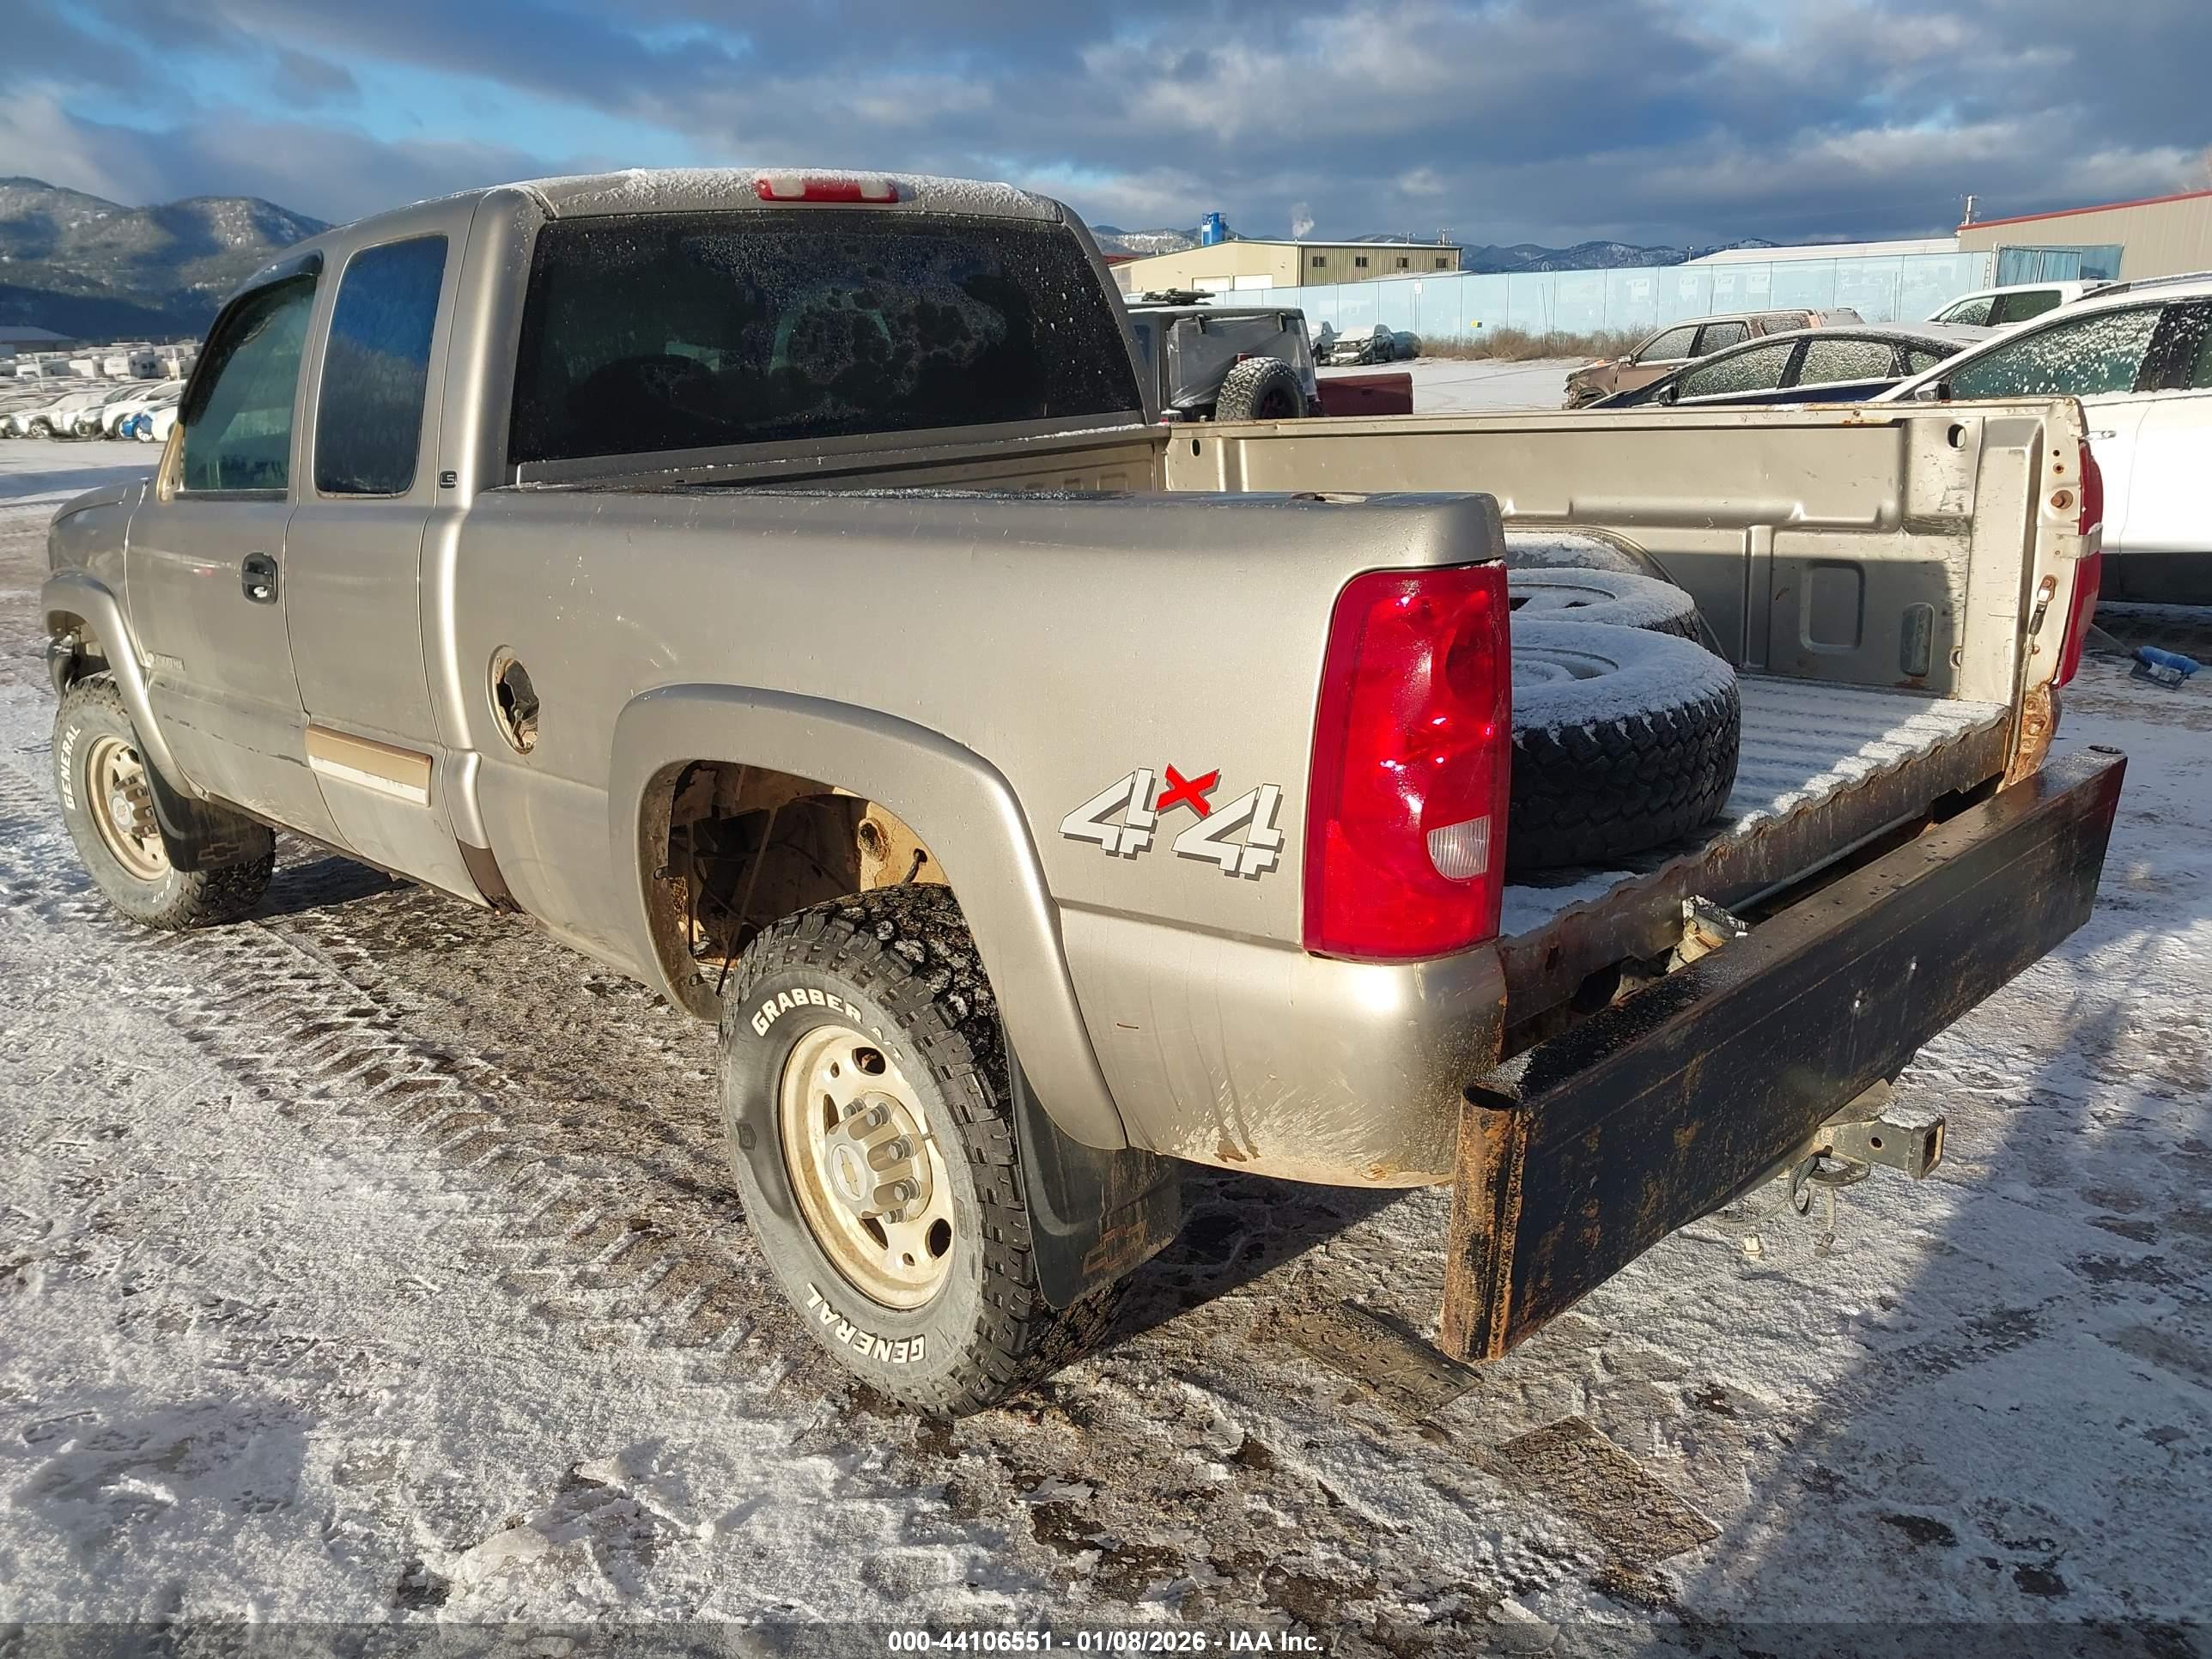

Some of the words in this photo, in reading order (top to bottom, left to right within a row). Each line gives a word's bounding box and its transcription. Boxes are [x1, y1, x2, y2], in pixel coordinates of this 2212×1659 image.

[60, 724, 82, 811] GENERAL
[750, 988, 865, 1038] GRABBER
[806, 1281, 927, 1364] GENERAL
